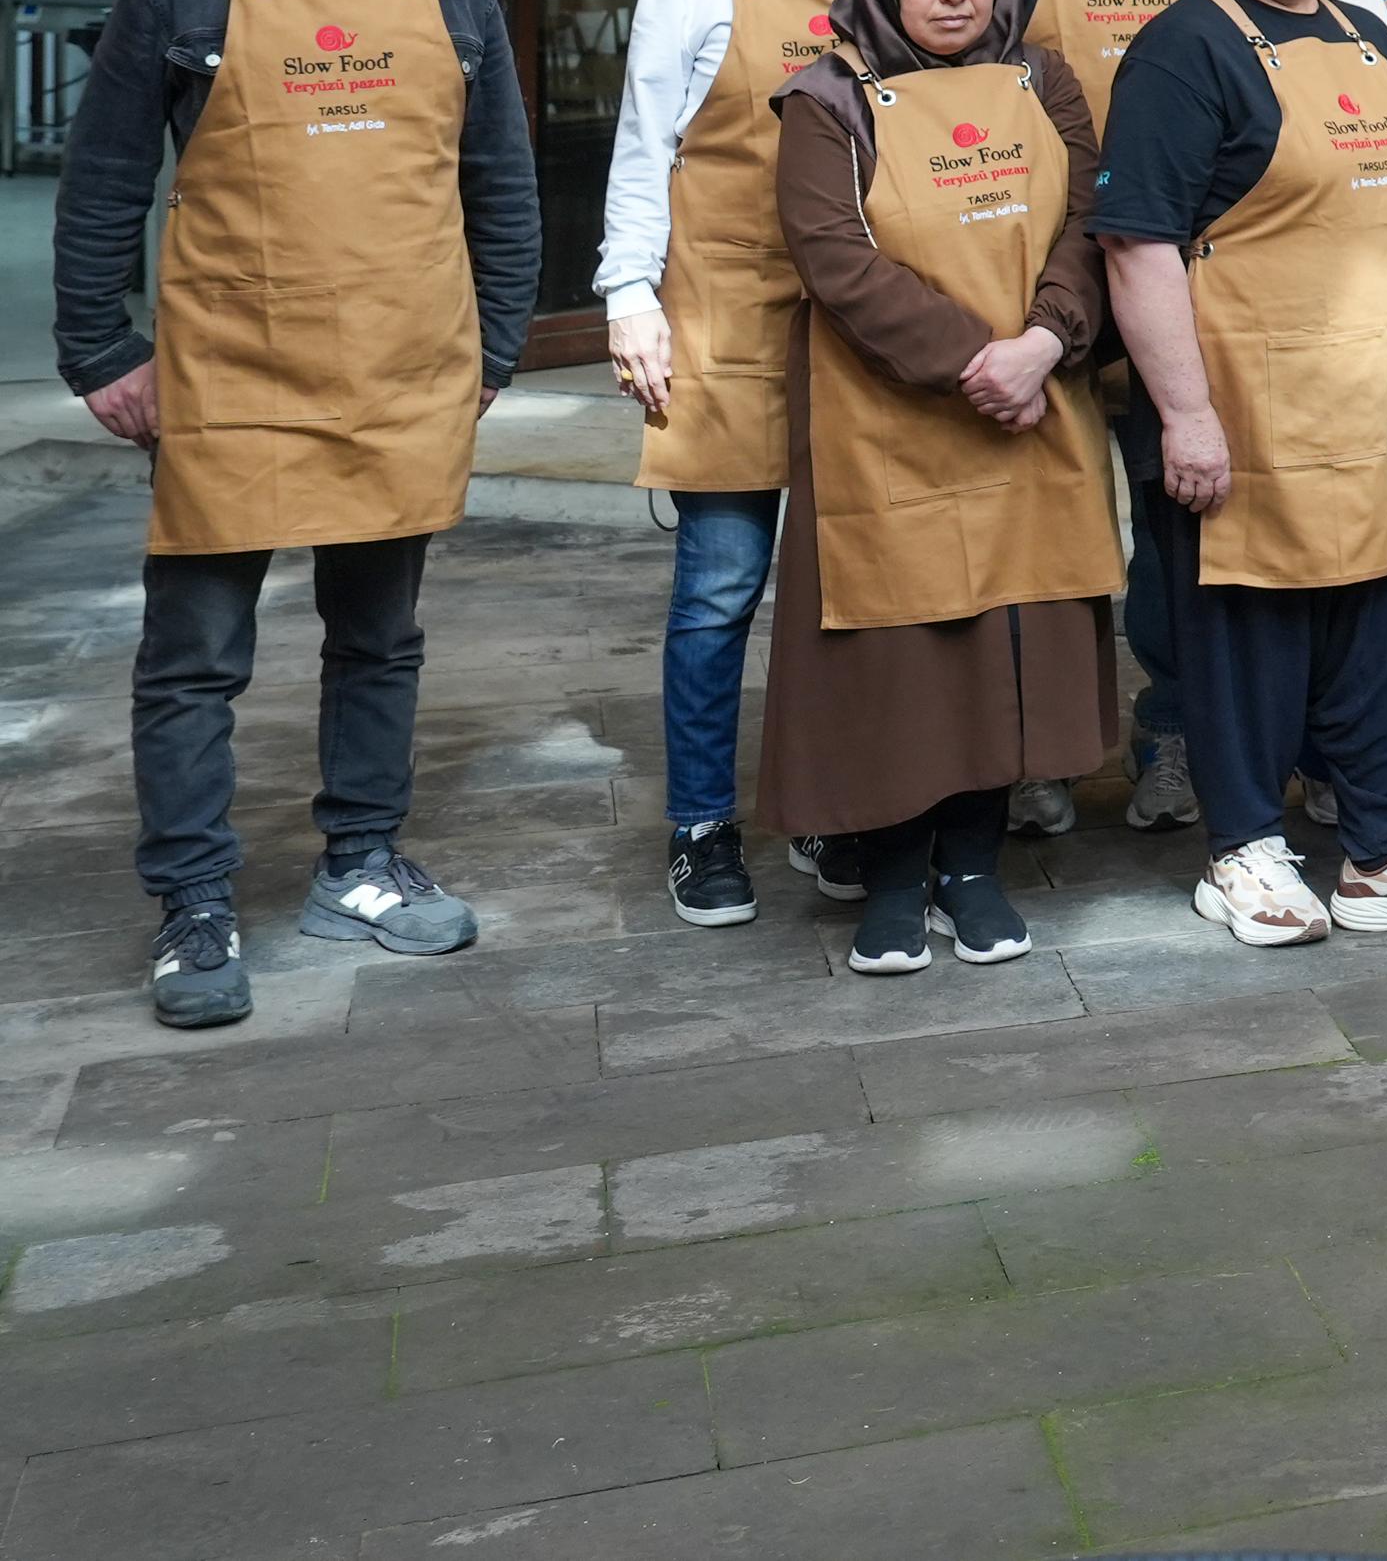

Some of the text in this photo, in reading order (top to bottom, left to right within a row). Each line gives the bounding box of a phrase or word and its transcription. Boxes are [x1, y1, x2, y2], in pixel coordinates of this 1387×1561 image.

[782, 41, 824, 58] Slow
[284, 56, 334, 75] Slow
[282, 79, 344, 95] Yeryüzü
[318, 104, 367, 116] TARSUS
[1324, 120, 1359, 135] Slow
[1330, 137, 1372, 152] Yeryüzü
[929, 155, 974, 173] Slow
[932, 172, 988, 188] Yeryüzü
[967, 190, 1012, 205] TARSUS
